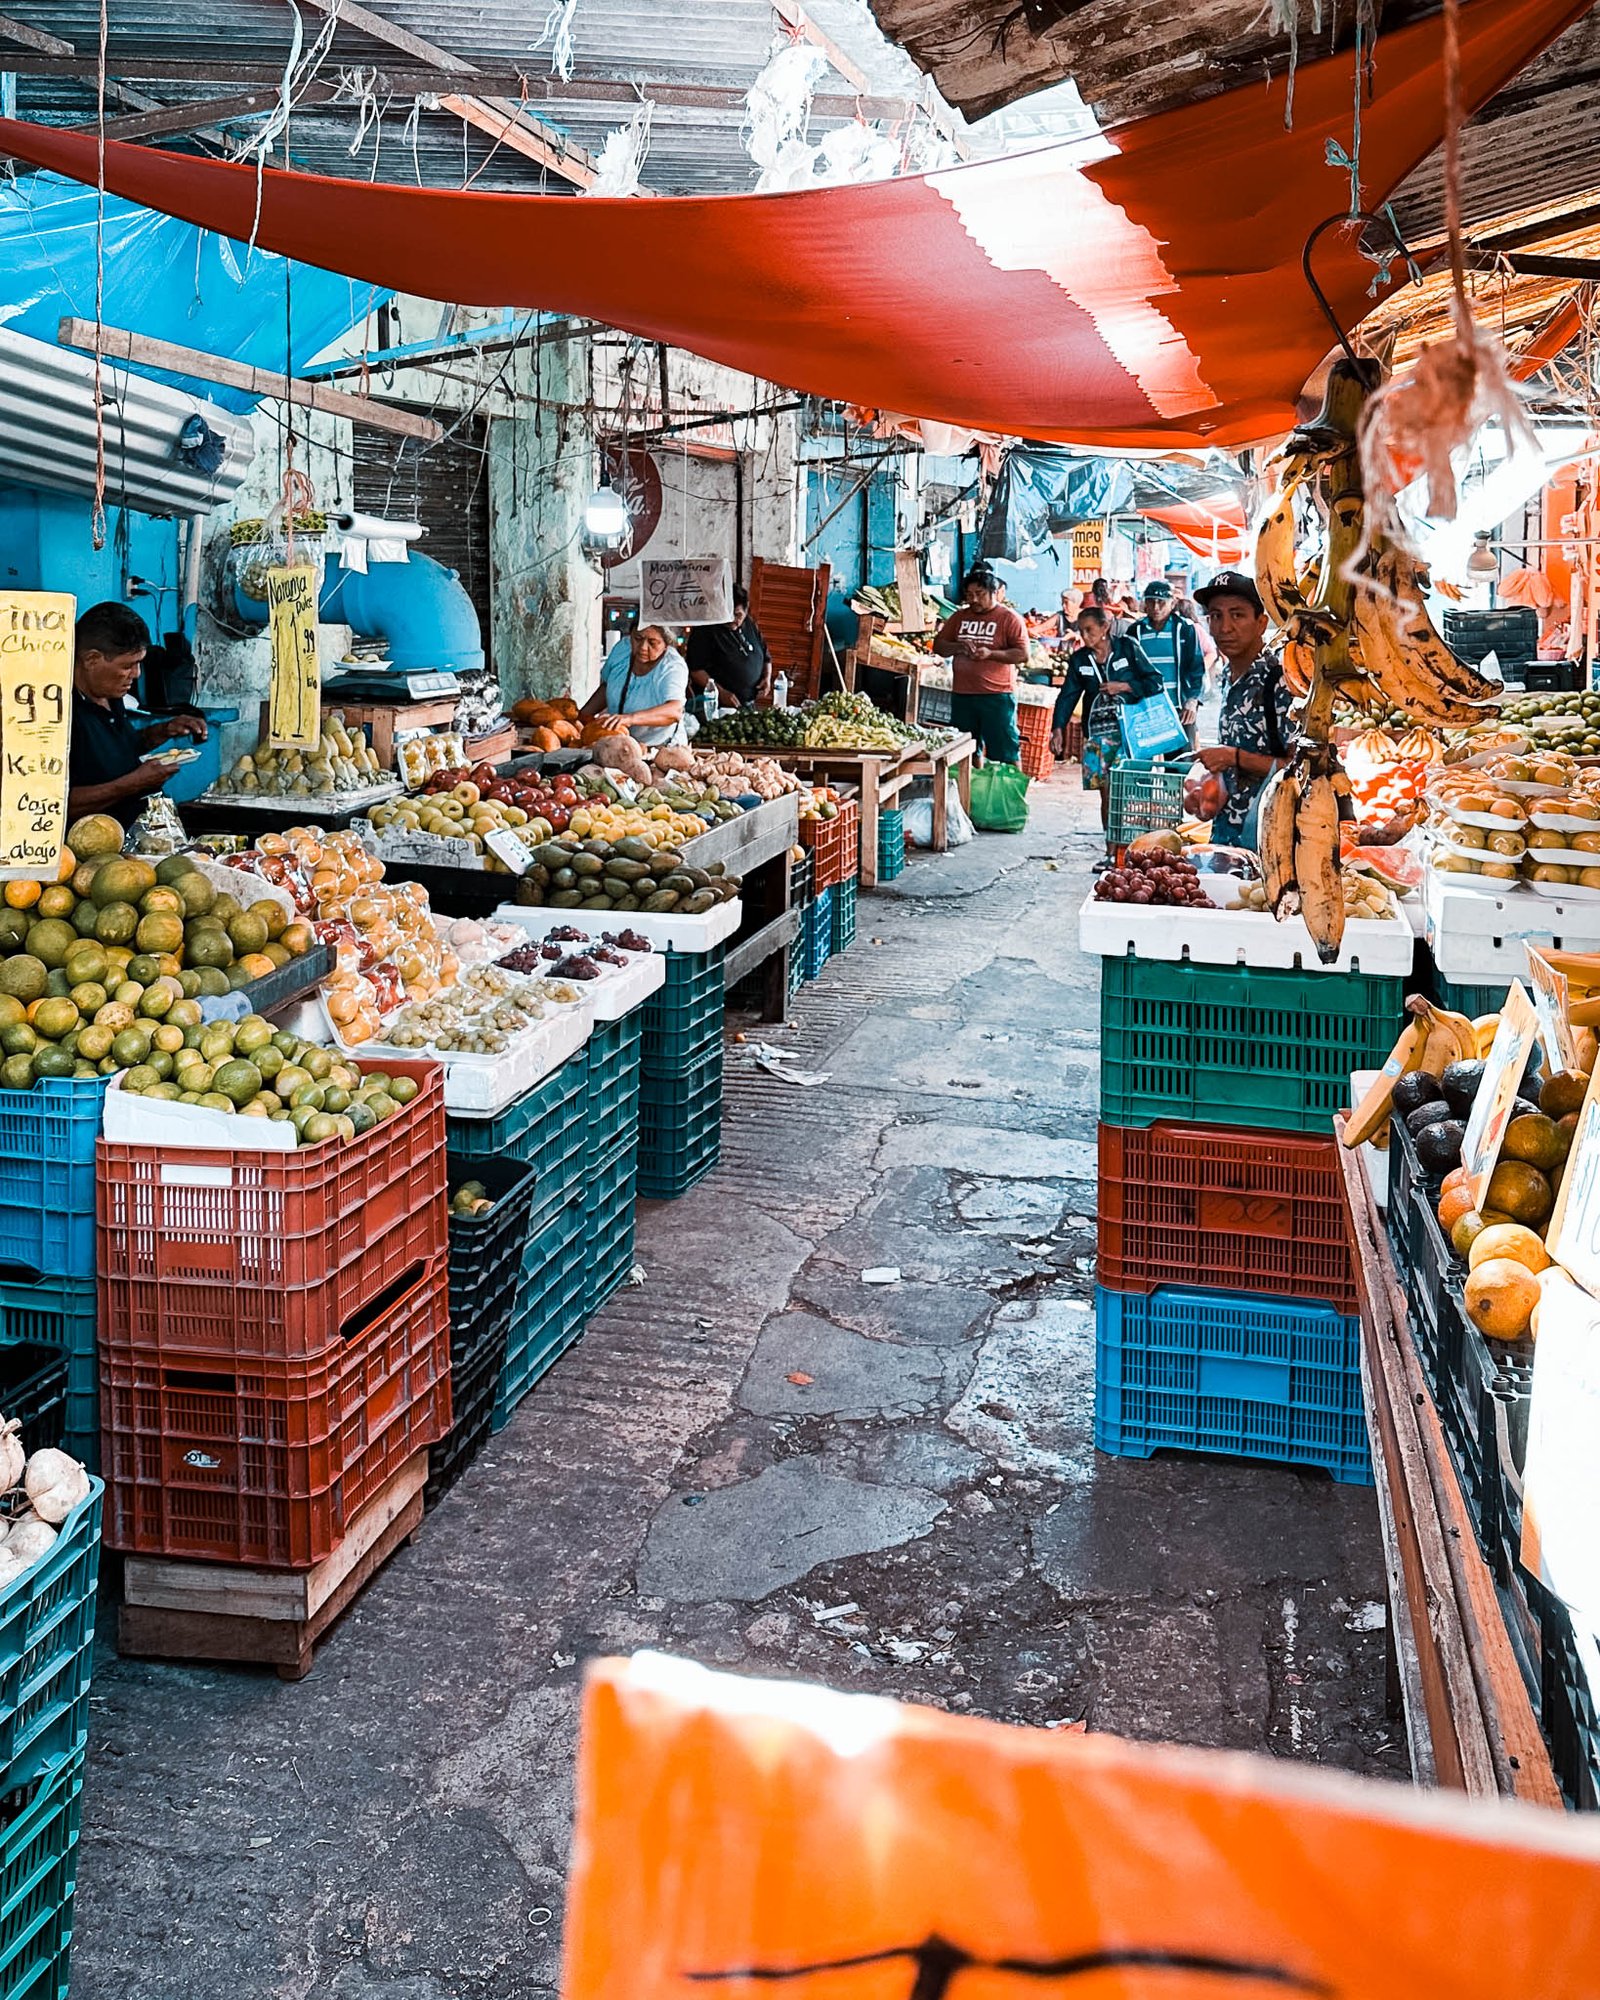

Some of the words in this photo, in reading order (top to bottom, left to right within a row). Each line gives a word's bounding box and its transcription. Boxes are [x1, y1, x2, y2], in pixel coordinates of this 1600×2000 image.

[959, 621, 997, 636] POLO
[31, 817, 54, 832] de
[9, 839, 57, 864] abajo
